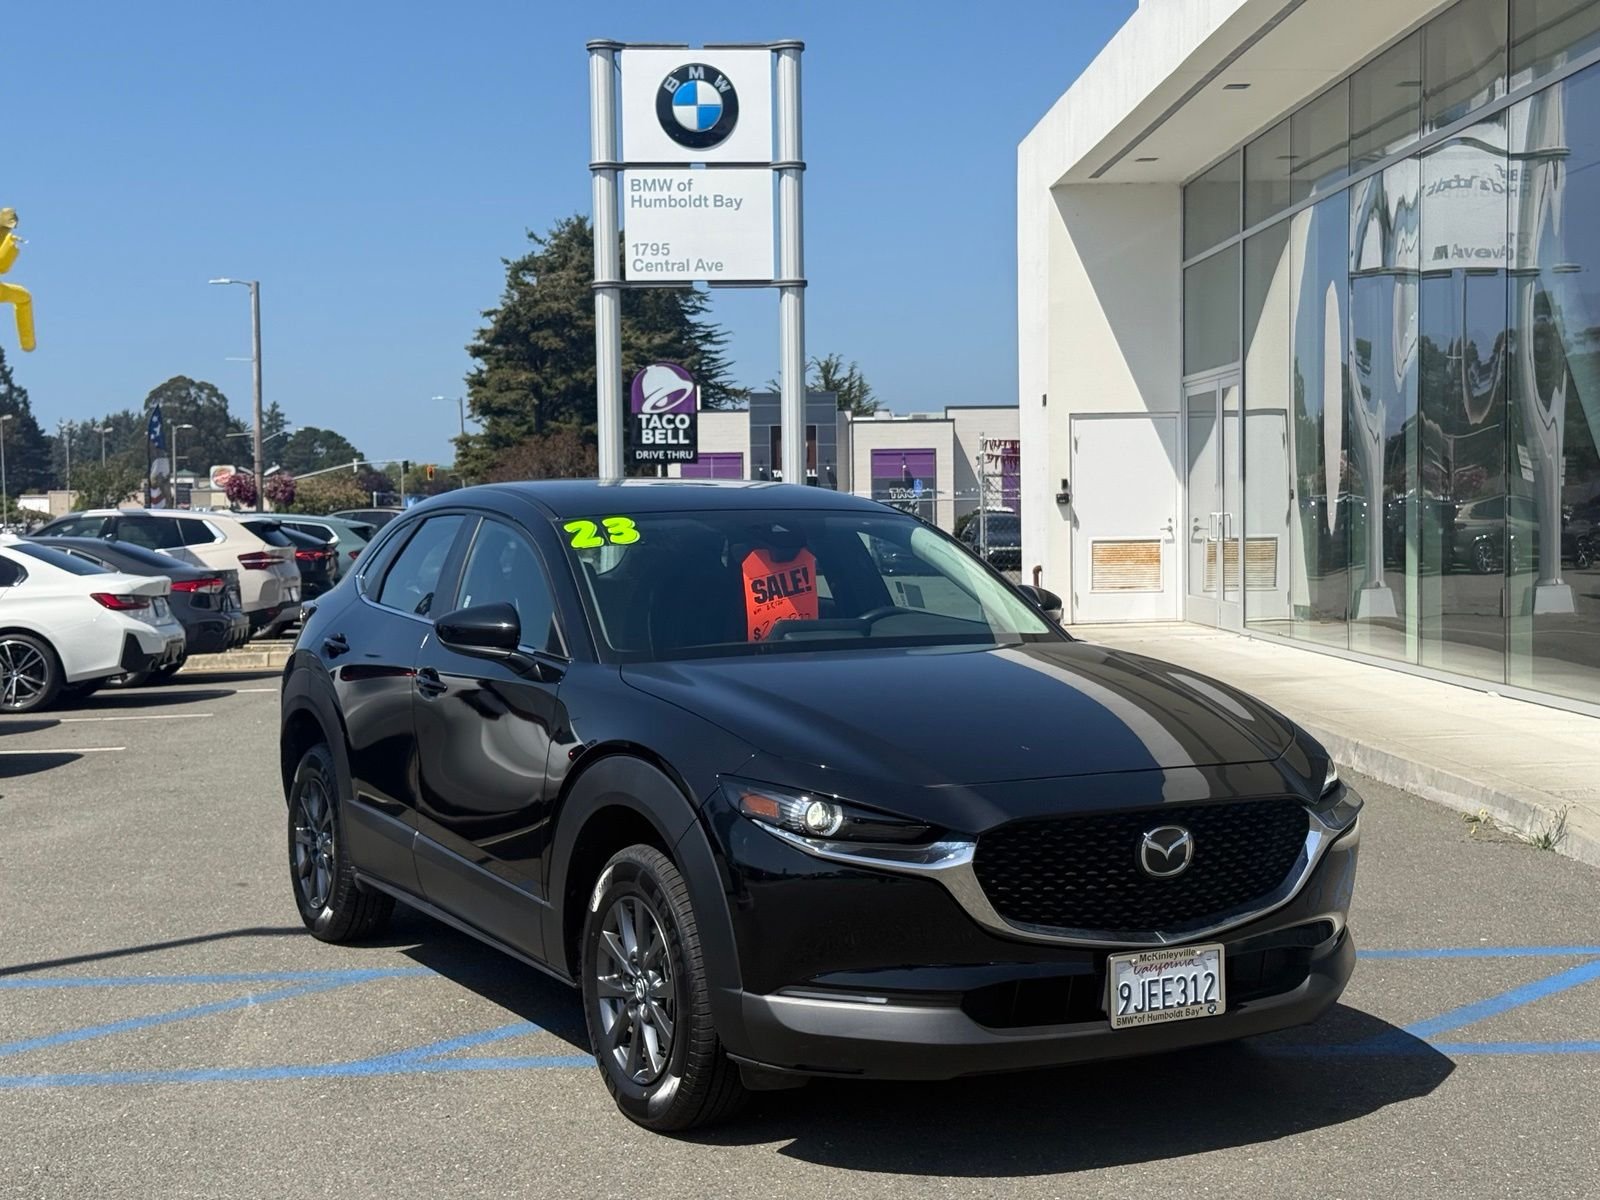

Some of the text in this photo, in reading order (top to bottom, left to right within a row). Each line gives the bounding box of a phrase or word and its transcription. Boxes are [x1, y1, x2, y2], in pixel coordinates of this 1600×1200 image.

[663, 66, 731, 94] BMW
[630, 179, 693, 192] BMW of
[630, 195, 743, 211] Humboldt Bay
[632, 243, 671, 256] 1795
[632, 259, 724, 272] Central Ave
[637, 414, 690, 429] TACO
[641, 429, 690, 444] BELL
[635, 450, 694, 460] DRIVE THRU
[563, 517, 641, 549] 23
[751, 567, 812, 604] SALE!
[1139, 948, 1197, 962] McKinleyville
[1133, 958, 1201, 976] California
[1118, 971, 1217, 1016] 9JEE312
[1137, 1014, 1146, 1024] of
[1147, 1009, 1183, 1023] Humboldt
